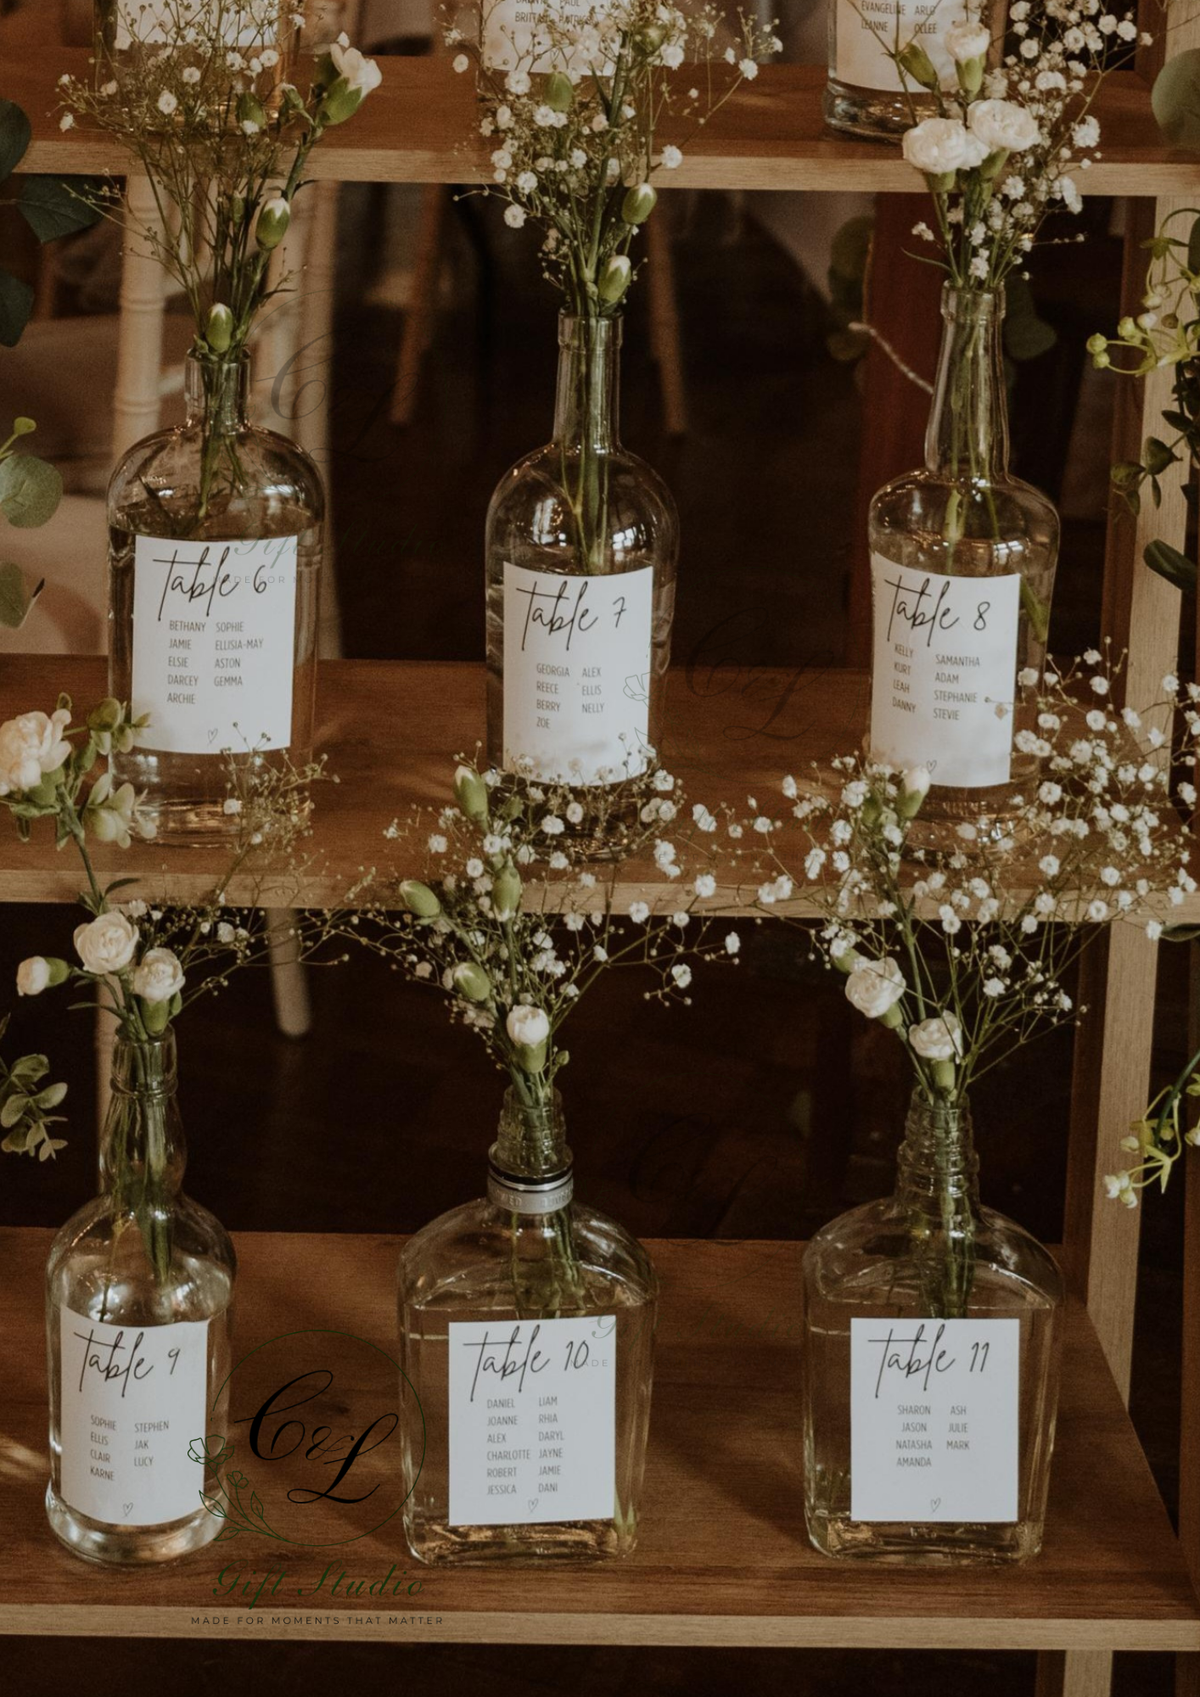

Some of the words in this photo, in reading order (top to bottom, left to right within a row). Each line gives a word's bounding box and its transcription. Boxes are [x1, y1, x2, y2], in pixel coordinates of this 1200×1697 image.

[914, 5, 936, 16] ARLO
[253, 564, 267, 594] 6
[612, 596, 627, 628] 7
[973, 601, 991, 631] 8
[169, 620, 206, 632] BETHANY
[216, 621, 244, 632] SOPHIE
[168, 638, 192, 650] JAMIE
[215, 638, 264, 651] ELLISIA-MAY
[894, 643, 914, 658] KELLY
[936, 654, 980, 667] SAMANTHA
[168, 656, 188, 668] ELSIE
[214, 658, 240, 669] ASTON
[536, 663, 570, 677] GEORGIA
[582, 667, 602, 678] ALEX
[894, 662, 911, 676] KURT
[934, 672, 959, 684] ADAM
[168, 674, 199, 686] DARCEY
[214, 676, 242, 686] GEMMA
[536, 680, 559, 694] REECE
[582, 685, 602, 696] ELLIS
[893, 678, 910, 694] LEAH
[934, 690, 978, 703] STEPHANIE
[167, 692, 196, 704] ARCHIE
[536, 698, 560, 712] BERRY
[582, 702, 605, 714] NELLY
[892, 696, 916, 714] DANNY
[934, 708, 960, 720] STEVIE
[536, 716, 550, 728] ZOE
[168, 1348, 181, 1375] 9
[564, 1340, 590, 1371] 10
[969, 1342, 990, 1372] 11
[487, 1398, 515, 1408] DANIEL
[538, 1396, 558, 1406] LIAM
[897, 1405, 932, 1416] SHARON
[950, 1405, 967, 1416] ASH
[90, 1414, 116, 1431] SOPHIE
[134, 1420, 170, 1433] STEPHEN
[487, 1415, 518, 1426] JOANNE
[538, 1414, 558, 1424] RHIA
[901, 1422, 927, 1432] JASON
[948, 1422, 968, 1432] JULIE
[90, 1431, 108, 1446] ELLIS
[134, 1440, 149, 1450] JAK
[486, 1433, 506, 1444] ALEX
[538, 1431, 564, 1442] DARYL
[896, 1440, 932, 1450] NATASHA
[946, 1440, 970, 1450] MARK
[90, 1449, 110, 1463] CLAIR
[134, 1456, 154, 1467] LUCY
[486, 1449, 530, 1461] CHARLOTTE
[538, 1448, 563, 1458] JAYNE
[896, 1457, 932, 1467] AMANDA
[90, 1466, 115, 1482] KARNE
[486, 1467, 517, 1478] ROBERT
[538, 1465, 561, 1476] JAMIE
[486, 1484, 517, 1496] JESSICA
[538, 1482, 558, 1494] DANI
